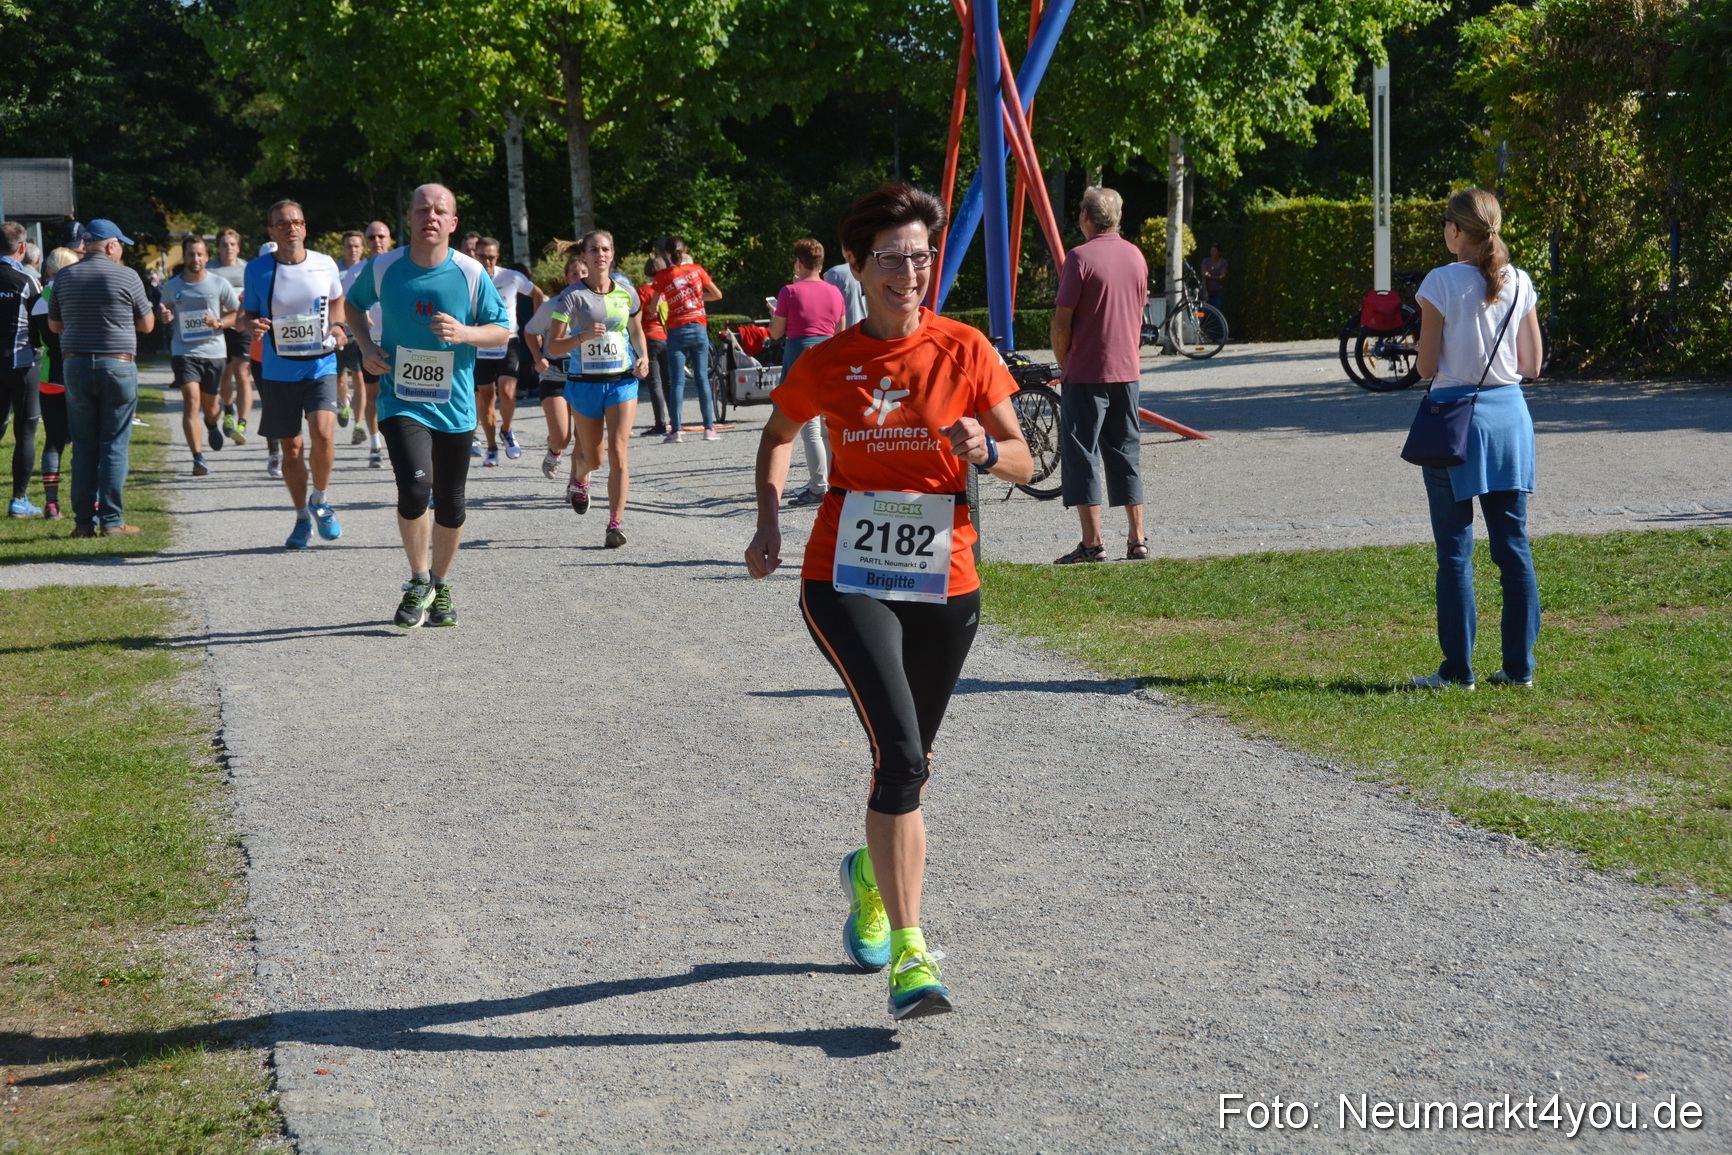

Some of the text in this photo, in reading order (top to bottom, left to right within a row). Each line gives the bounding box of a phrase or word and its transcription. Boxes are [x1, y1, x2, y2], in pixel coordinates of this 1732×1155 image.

[281, 324, 314, 339] 2504
[587, 343, 618, 356] 3140
[412, 354, 438, 362] BOCK
[402, 362, 444, 381] 2088
[405, 387, 437, 397] Reinhard
[842, 427, 928, 446] funrunners
[867, 438, 942, 453] neumarkt
[874, 500, 923, 515] BOCK
[842, 541, 848, 549] C
[854, 519, 936, 557] 2182
[860, 556, 917, 568] PARTL Neumarkt
[866, 572, 915, 590] Brigitte
